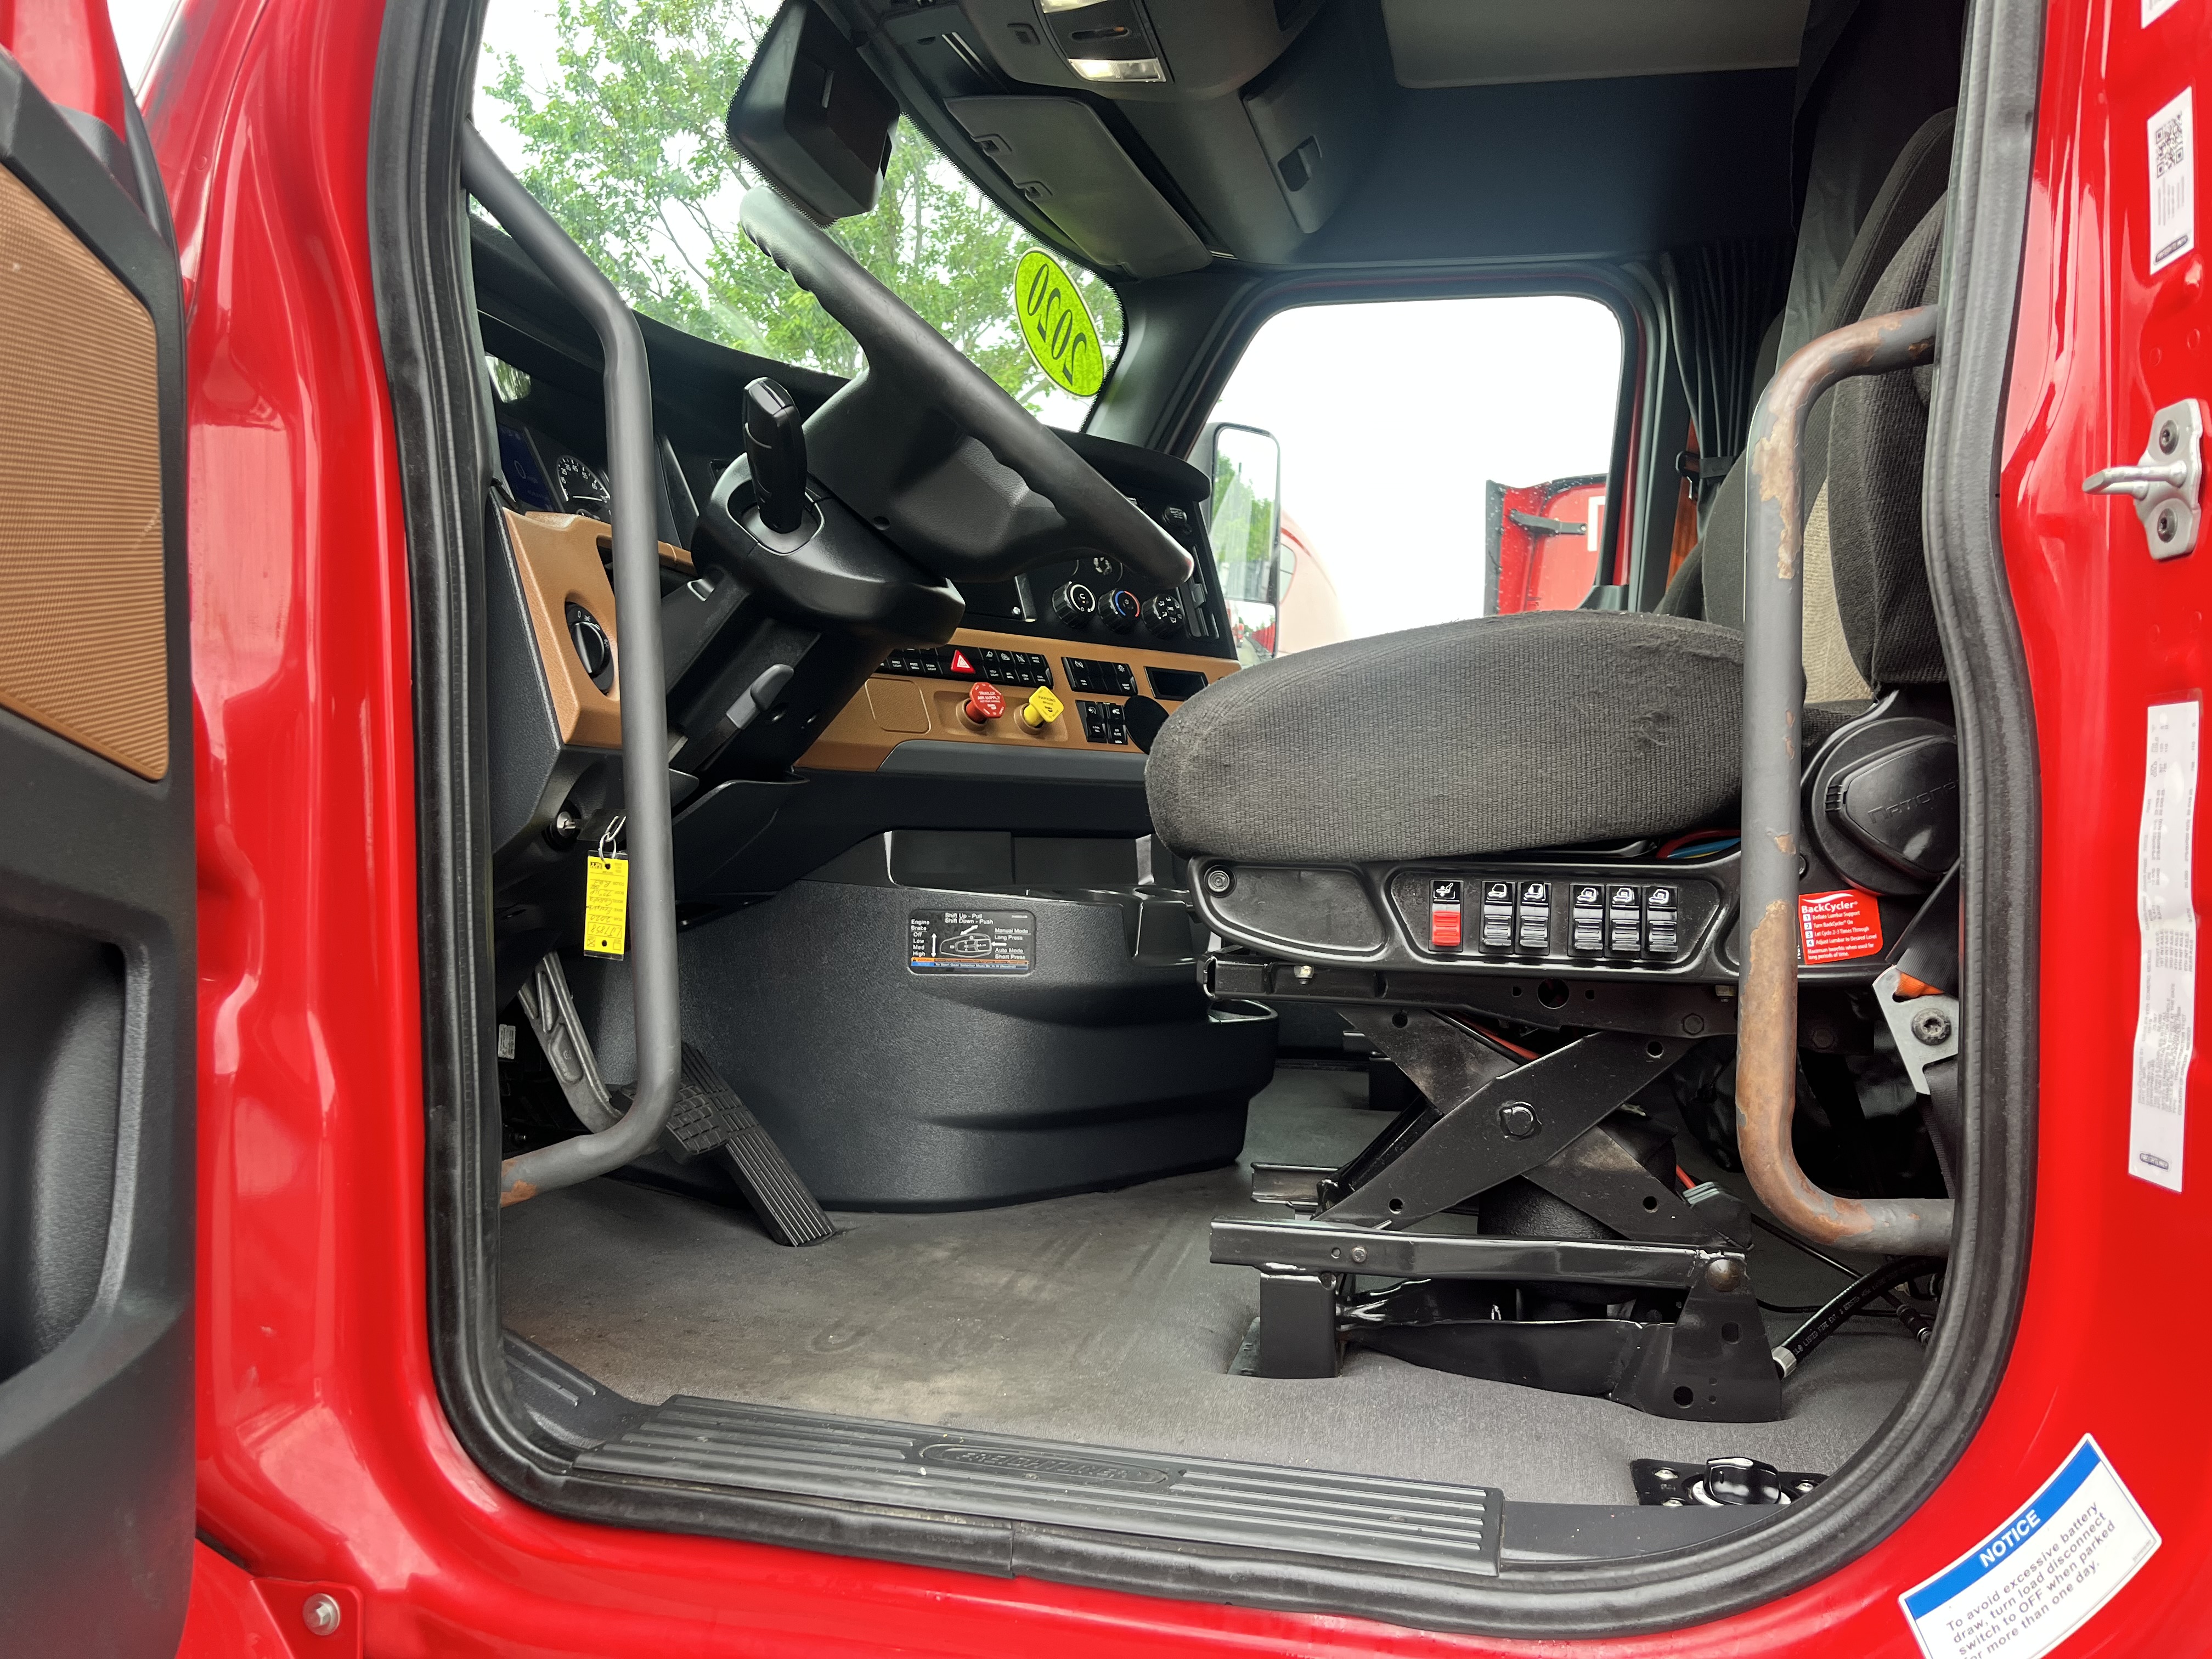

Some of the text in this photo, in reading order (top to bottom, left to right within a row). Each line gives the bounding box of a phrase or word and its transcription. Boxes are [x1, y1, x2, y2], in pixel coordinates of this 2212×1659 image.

[1802, 1328, 1819, 1348] LISTED
[1818, 1319, 1830, 1334] FIRE
[1946, 1500, 2099, 1632] To avoid excessive battery
[1953, 1621, 1989, 1644] draw,
[1989, 1598, 2017, 1620] turn
[2019, 1572, 2045, 1599] load
[2047, 1514, 2107, 1575] disconnect
[1959, 1623, 2001, 1655] switch
[2003, 1611, 2017, 1626] to
[2018, 1590, 2044, 1613] OFF
[2046, 1561, 2079, 1592] when
[2079, 1522, 2116, 1565] parked
[1979, 1509, 2042, 1569] NOTICE
[1987, 1627, 2020, 1653] more
[2021, 1605, 2050, 1629] than
[2052, 1584, 2074, 1605] one
[2075, 1561, 2100, 1584] day.
